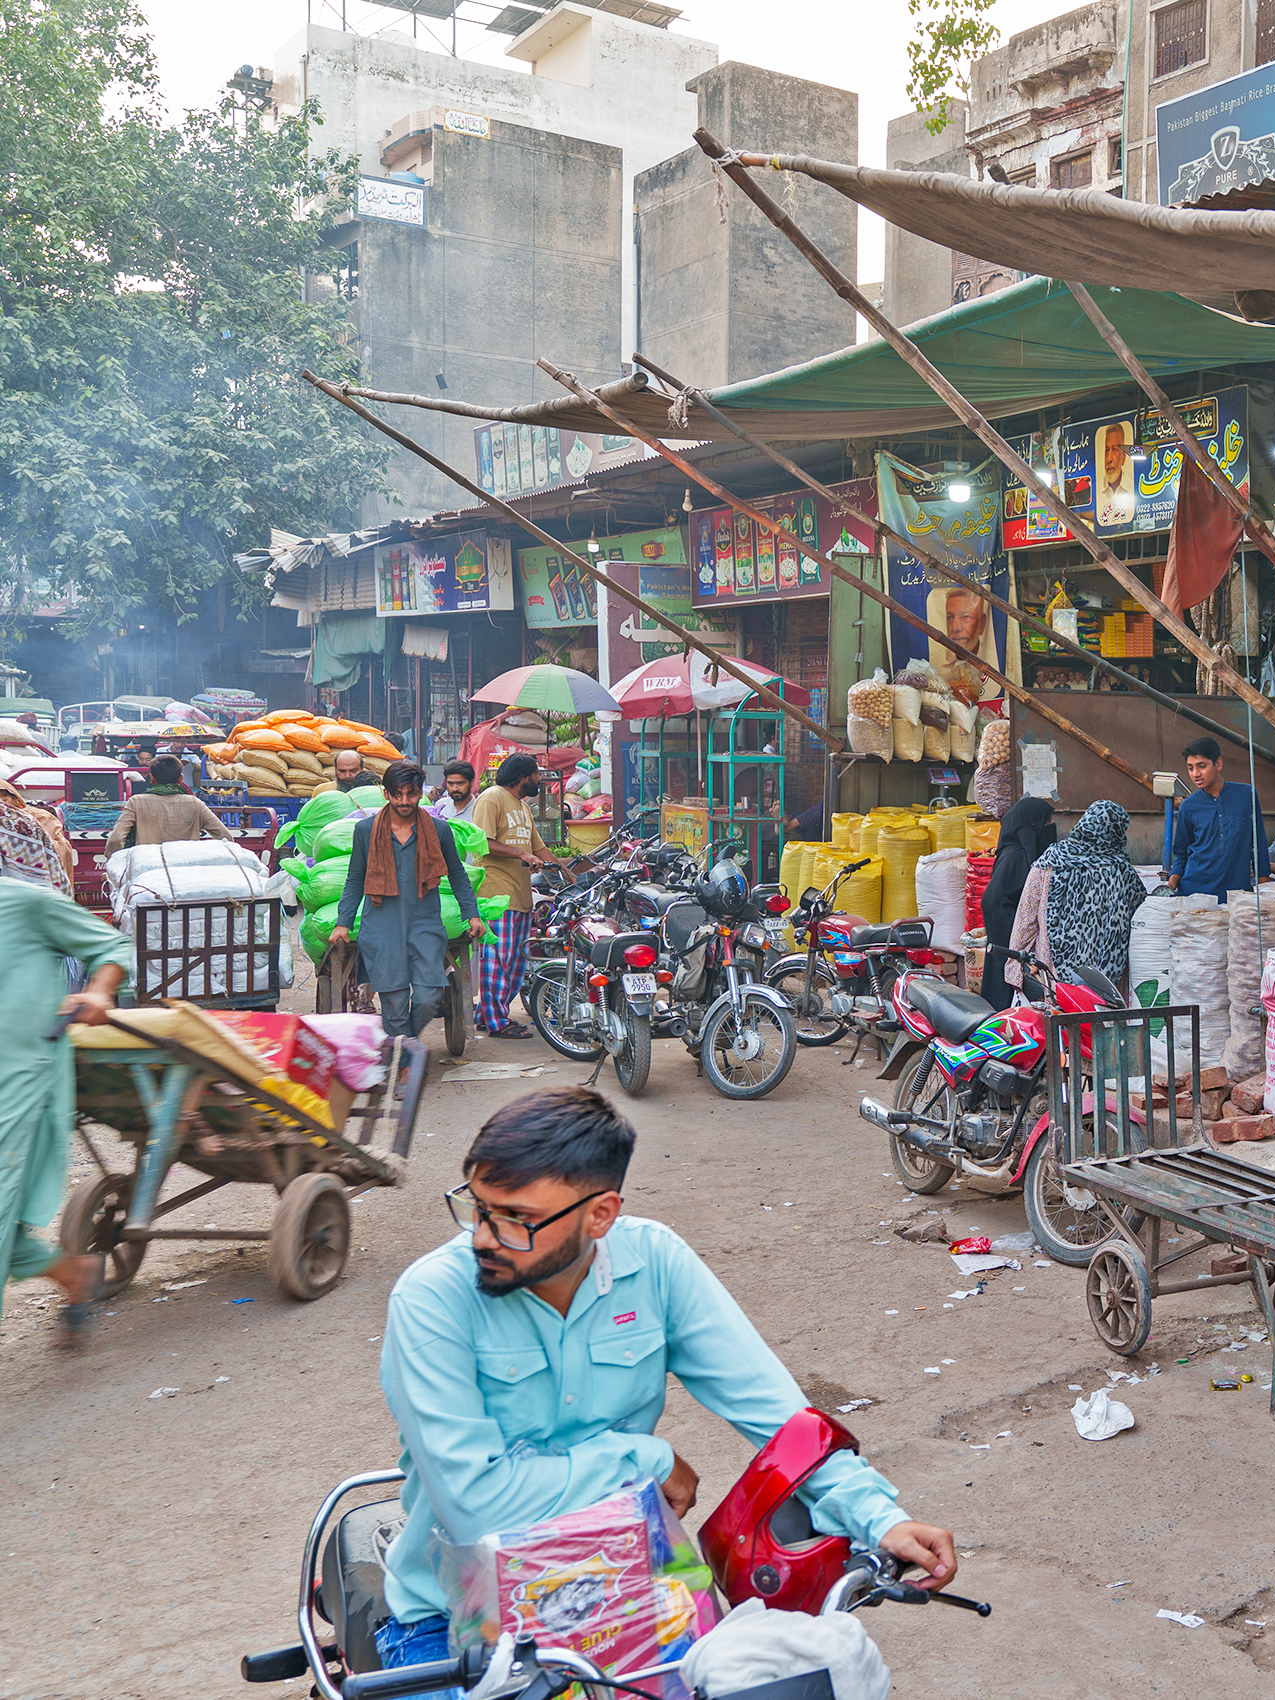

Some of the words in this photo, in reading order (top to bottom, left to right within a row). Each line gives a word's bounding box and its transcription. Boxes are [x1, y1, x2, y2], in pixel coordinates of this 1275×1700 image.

[1167, 115, 1194, 132] Pakistan
[1194, 105, 1219, 123] Biggest
[1219, 93, 1247, 113] Basmati
[1248, 88, 1264, 102] Rice
[1215, 169, 1238, 185] PURE
[1069, 432, 1090, 451] ہمارے
[958, 497, 998, 540] خلیفہ
[645, 677, 676, 688] WRM
[580, 1622, 622, 1646] GLUE
[583, 1639, 616, 1658] MOUS
